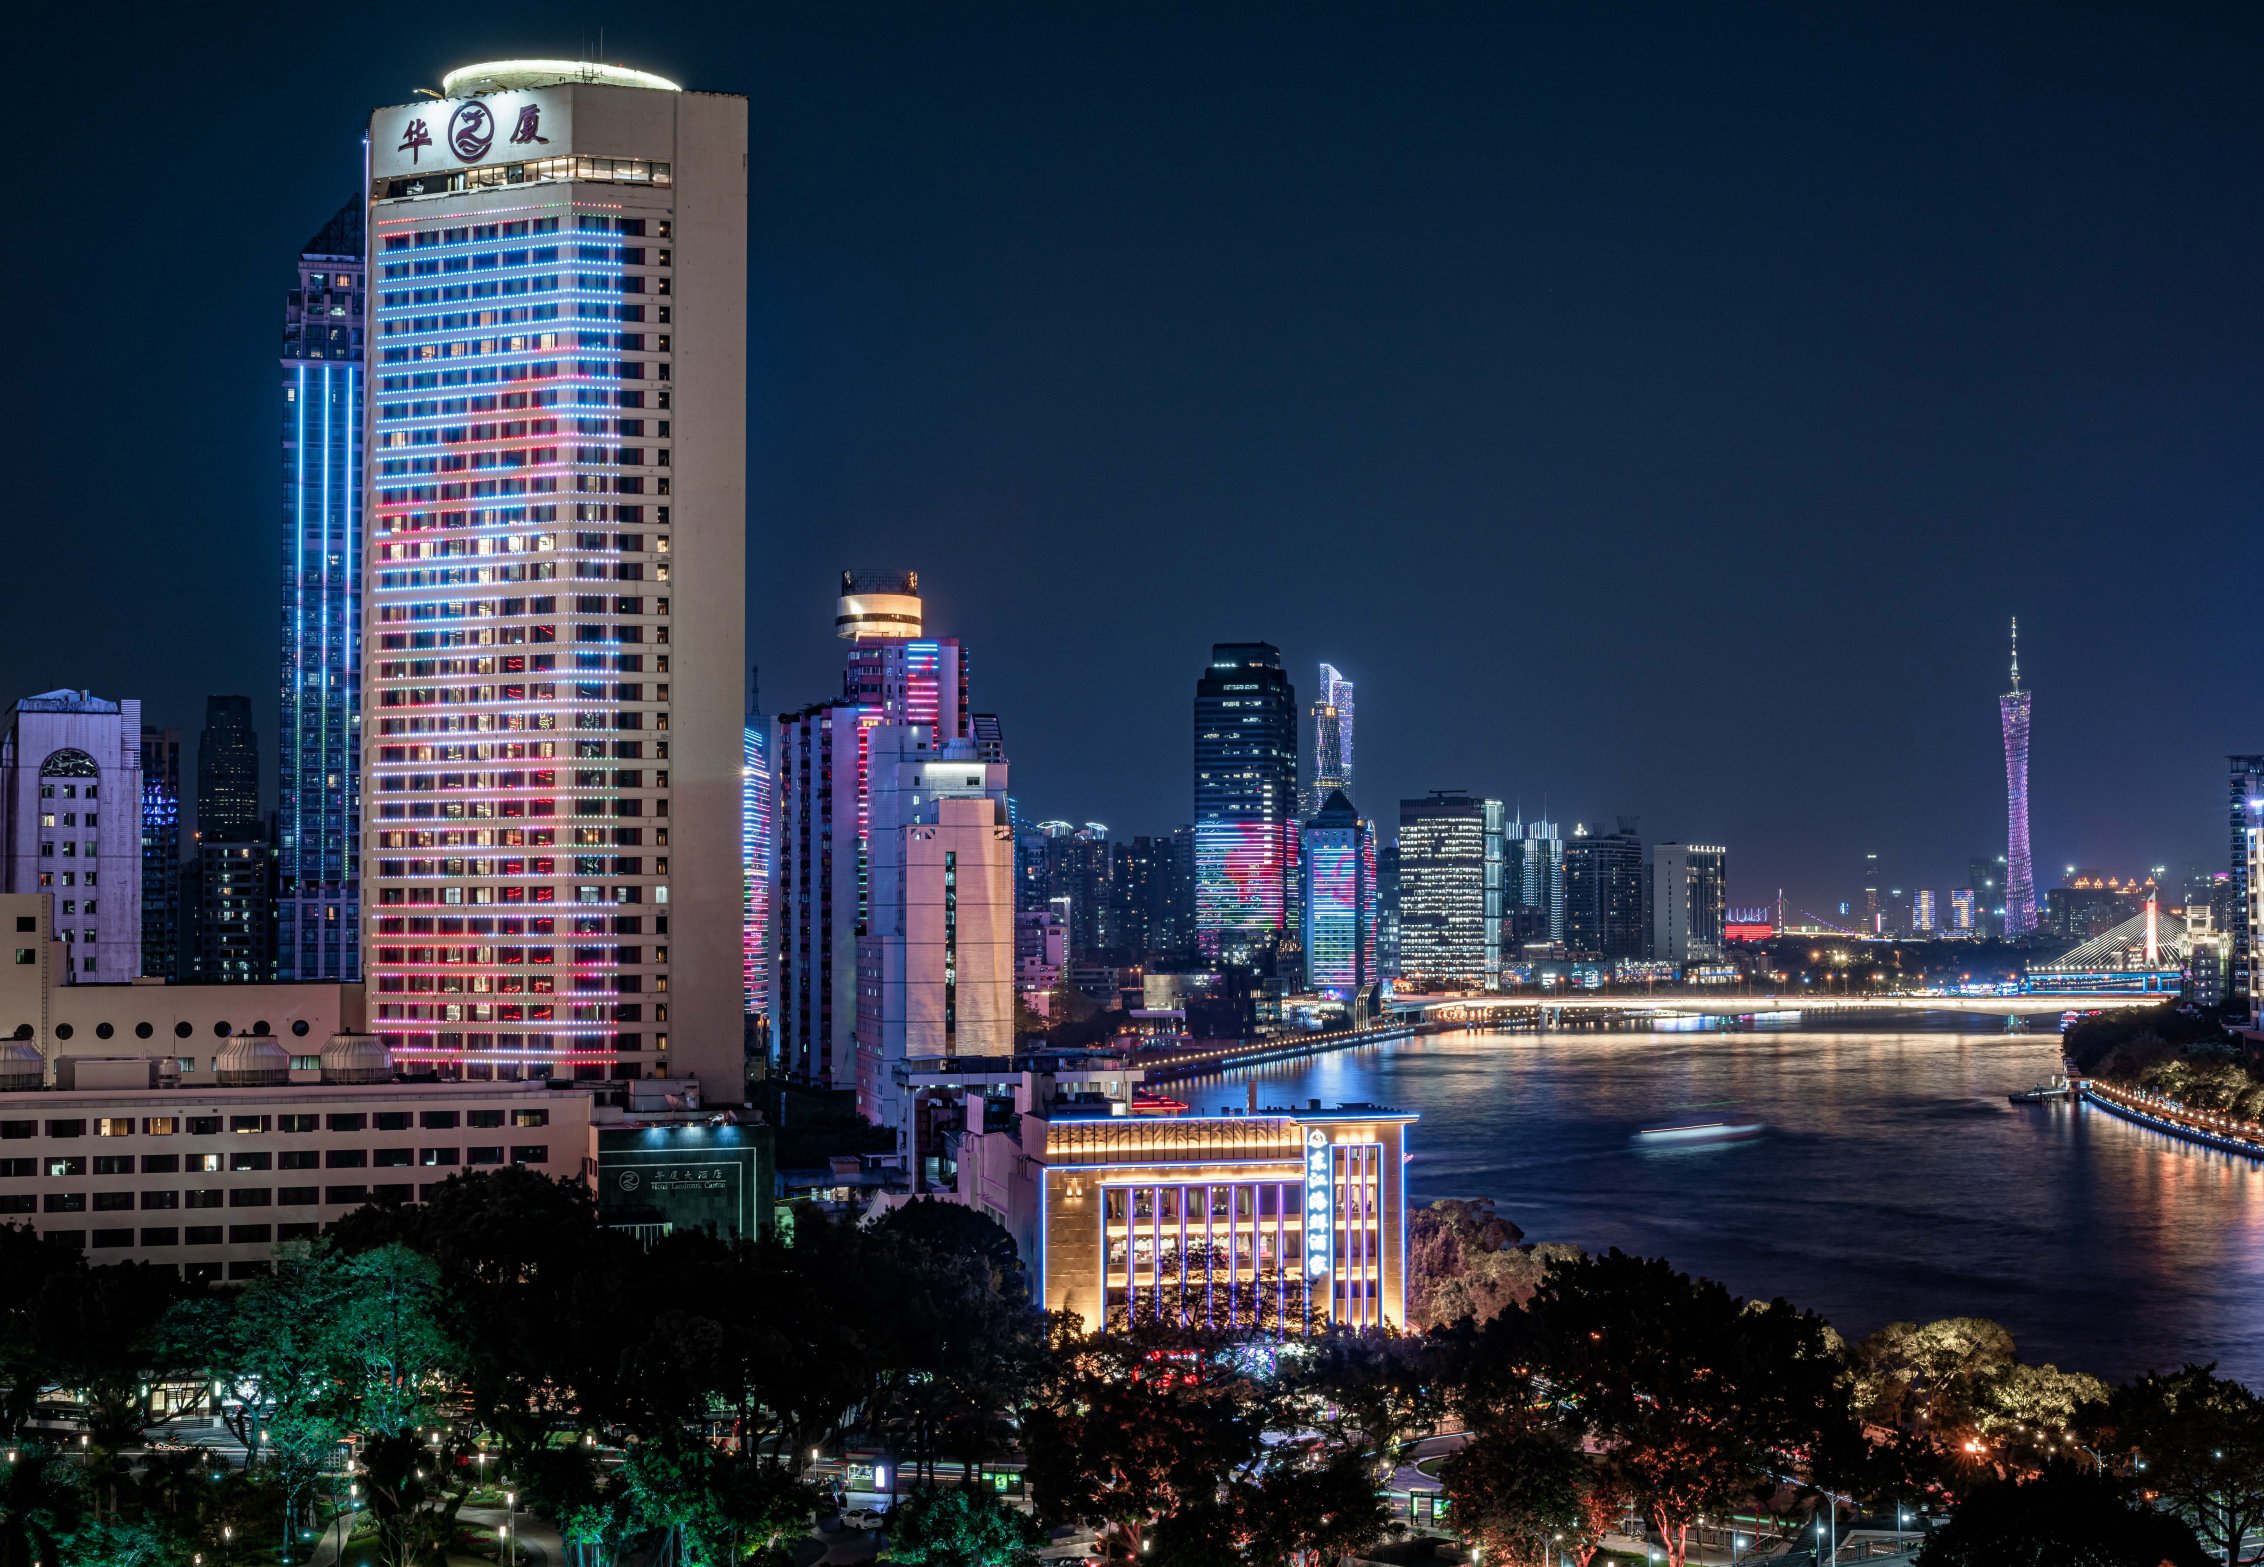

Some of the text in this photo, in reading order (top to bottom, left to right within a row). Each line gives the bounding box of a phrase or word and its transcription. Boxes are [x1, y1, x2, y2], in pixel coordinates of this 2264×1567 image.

[398, 103, 549, 164] 华 厦
[655, 1169, 722, 1181] 华厦大酒店
[652, 1181, 726, 1190] Hotel Landmark Canton
